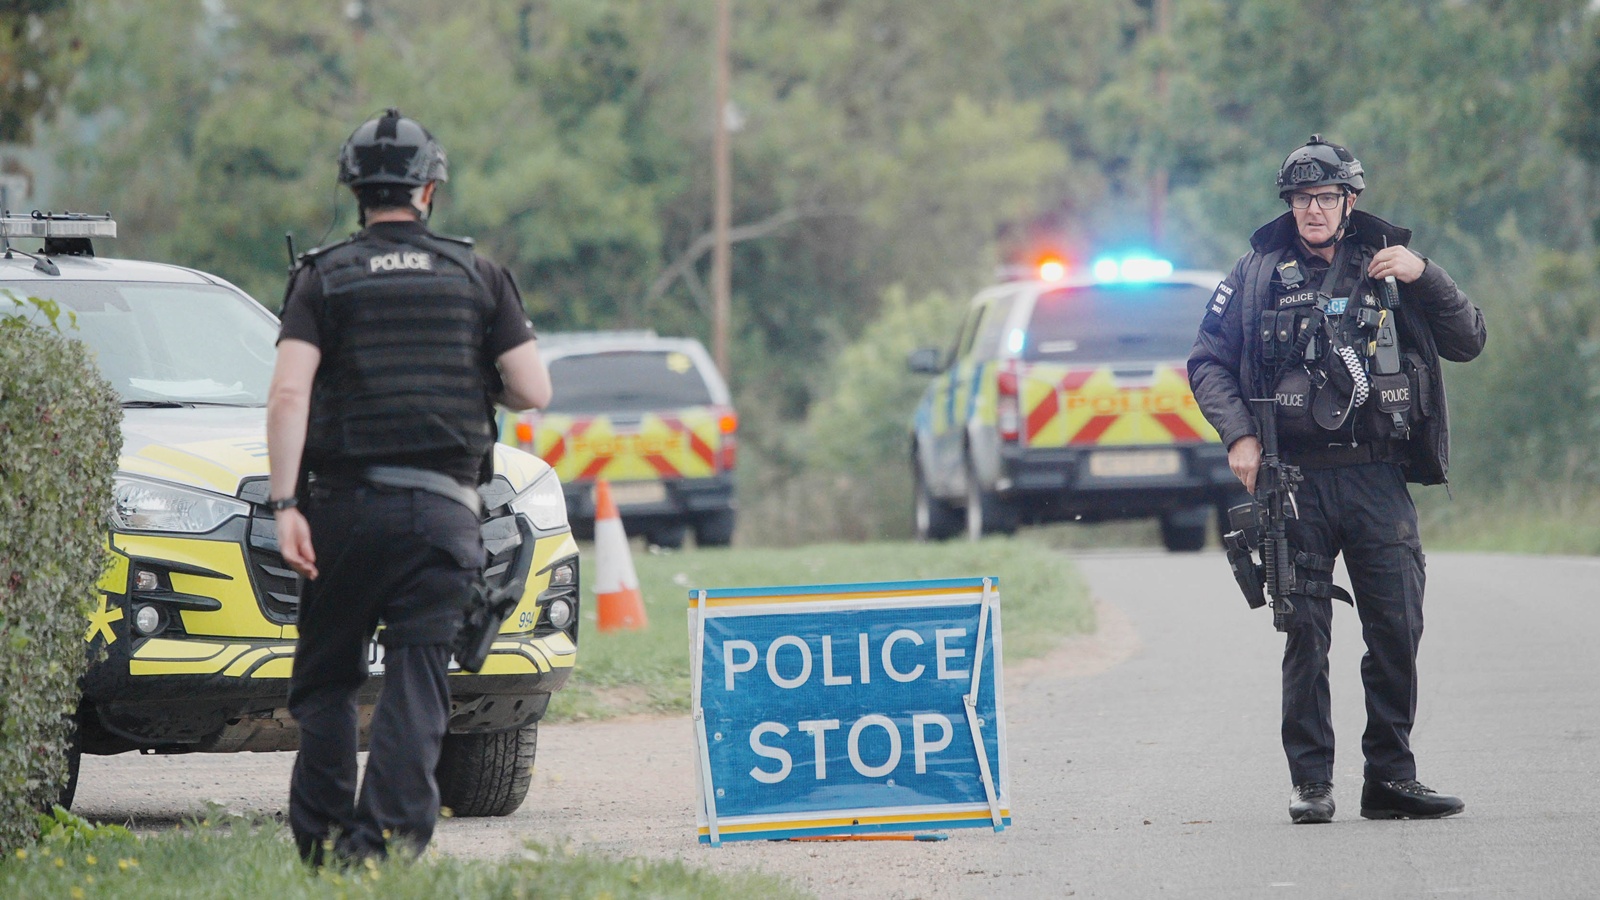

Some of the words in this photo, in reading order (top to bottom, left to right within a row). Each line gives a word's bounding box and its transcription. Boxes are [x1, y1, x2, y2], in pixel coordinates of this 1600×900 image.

[370, 252, 431, 272] POLICE
[1219, 283, 1233, 296] POLICE
[1280, 293, 1314, 306] POLICE
[1275, 393, 1304, 407] POLICE
[1381, 388, 1410, 403] POLICE
[722, 627, 970, 691] POLICE
[749, 712, 954, 784] STOP
